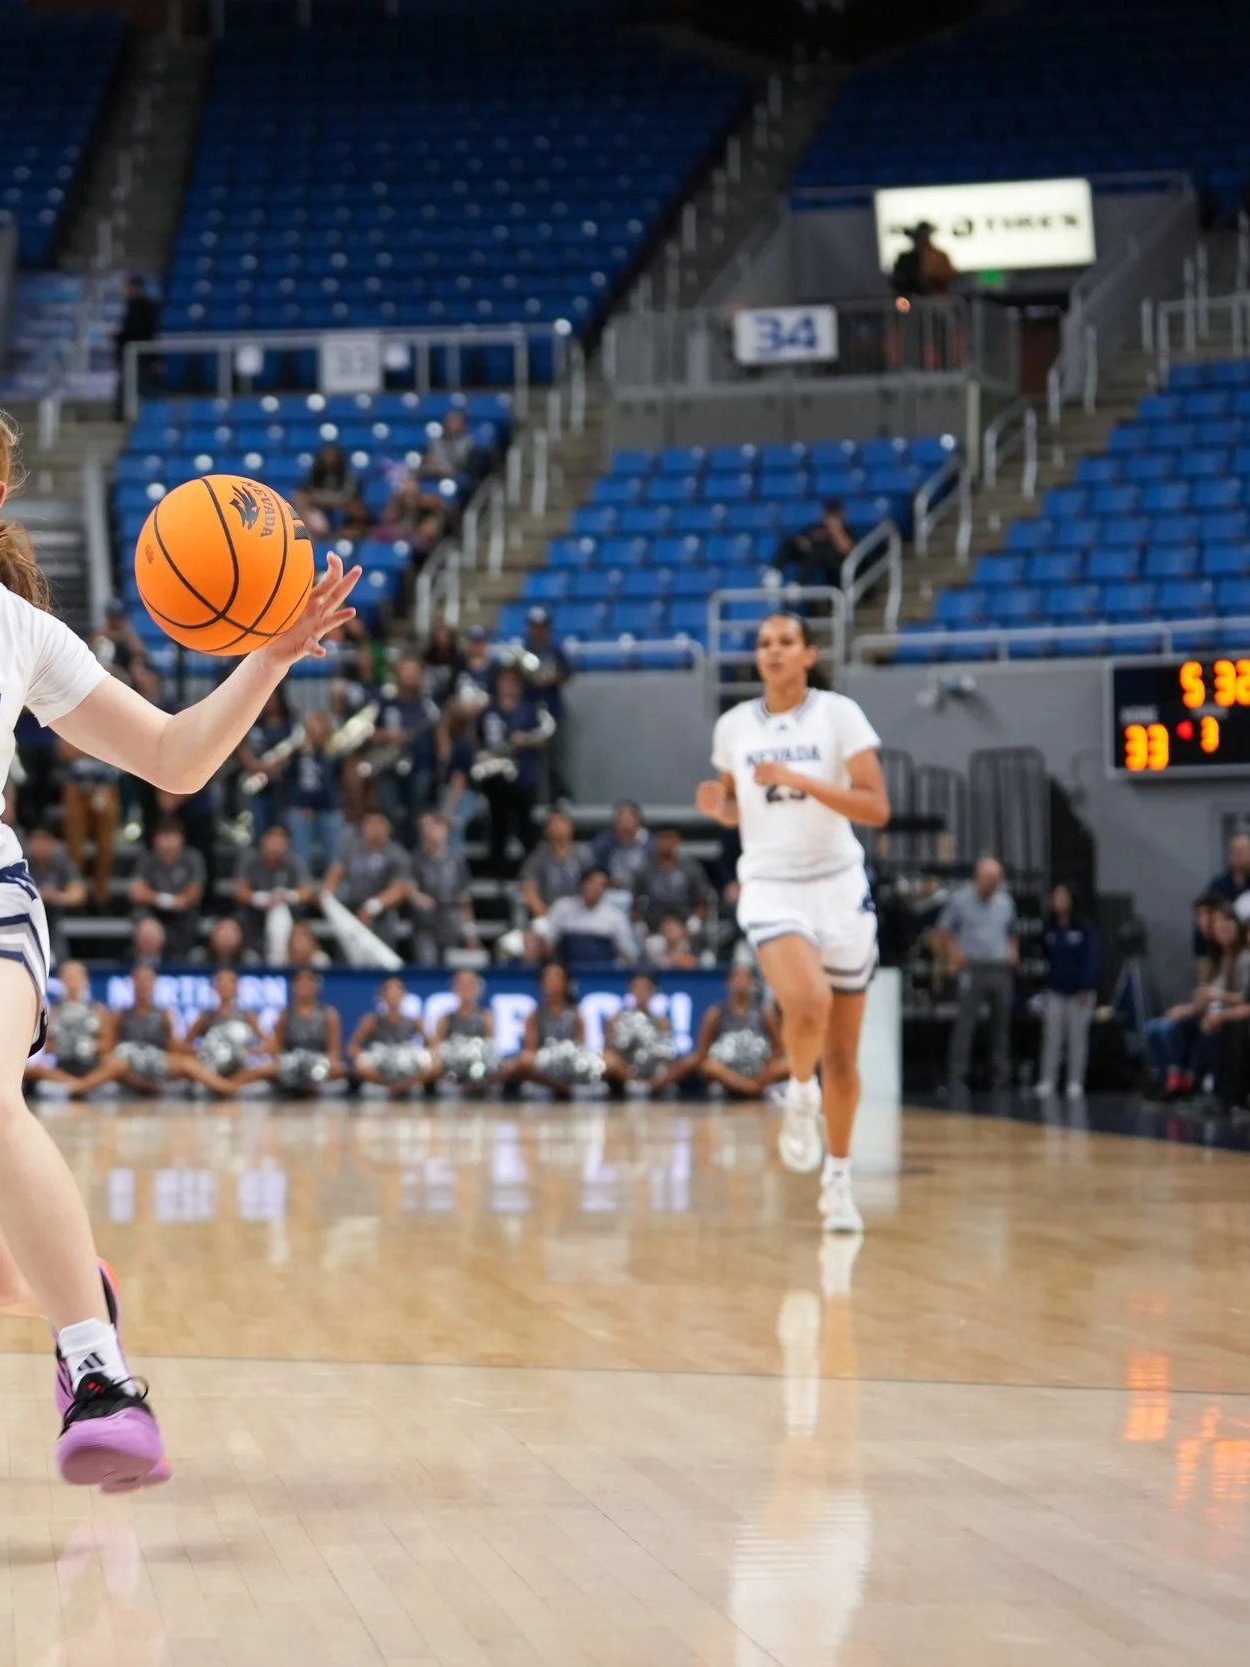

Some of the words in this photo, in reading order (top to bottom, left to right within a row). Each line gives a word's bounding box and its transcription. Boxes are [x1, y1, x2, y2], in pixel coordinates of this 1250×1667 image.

[755, 314, 817, 353] 34
[240, 480, 276, 537] NEVADA
[1125, 723, 1170, 773] 33
